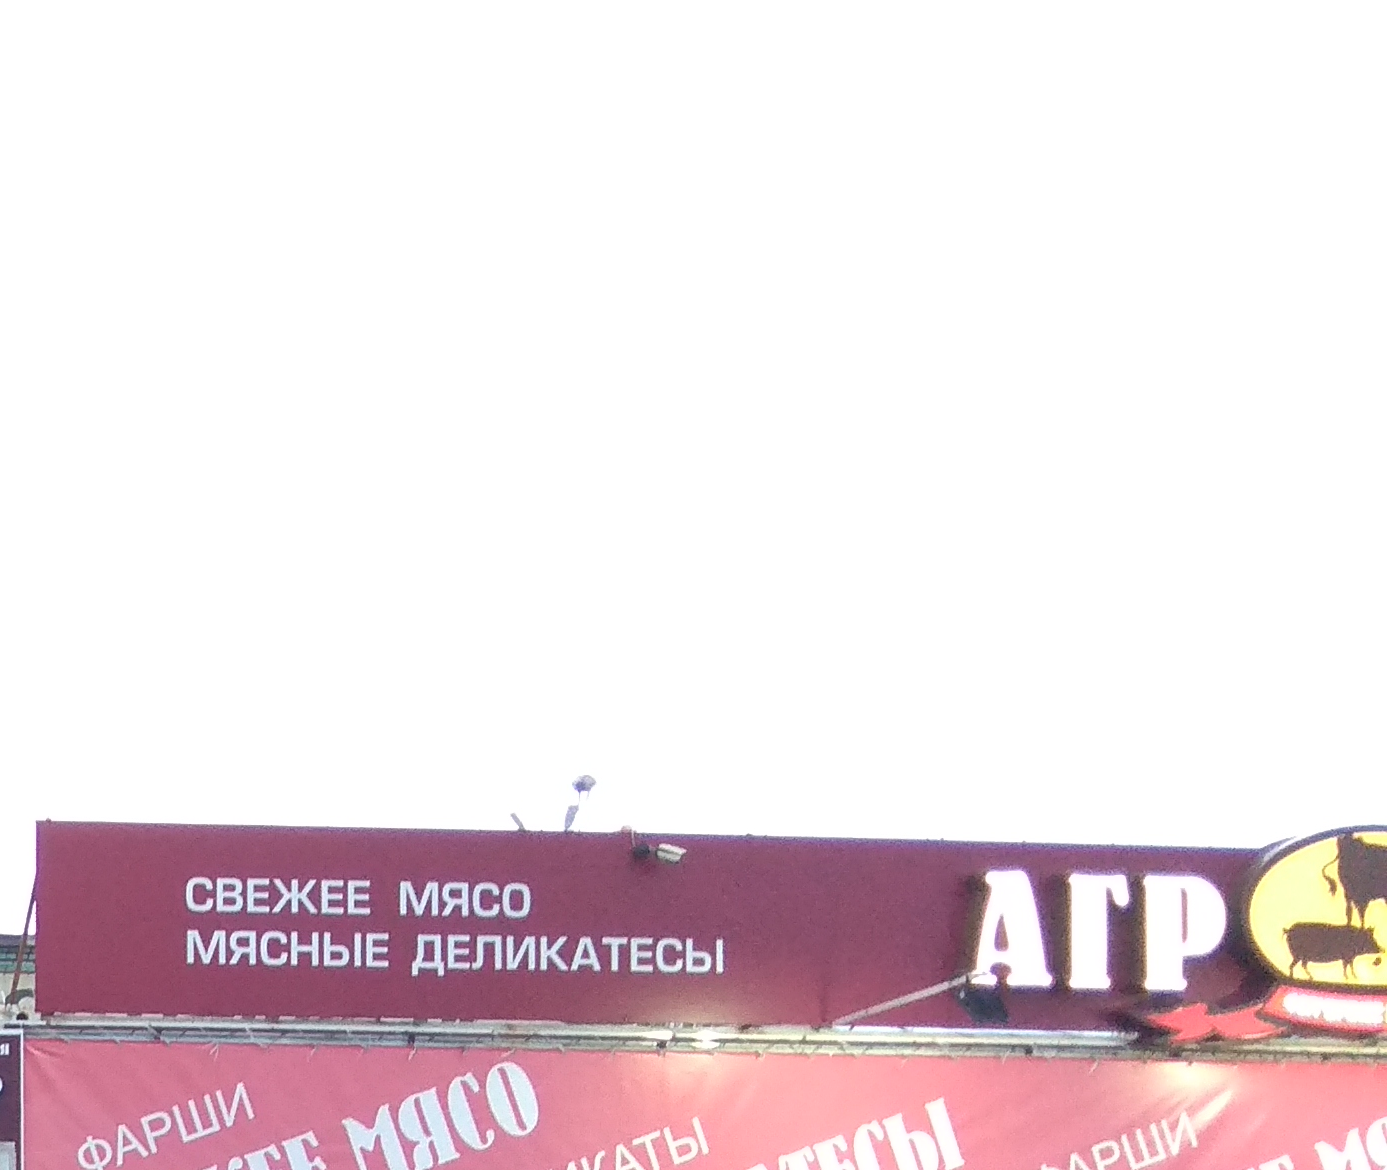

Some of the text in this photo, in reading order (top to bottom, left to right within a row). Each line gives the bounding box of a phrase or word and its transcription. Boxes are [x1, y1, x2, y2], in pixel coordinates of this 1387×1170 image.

[184, 876, 532, 920] СВЕЖЕЕ МЯСО
[184, 928, 725, 977] МЯСНЫЕ ДЕЛИКАТЕСЫ
[970, 868, 1228, 991] АГР
